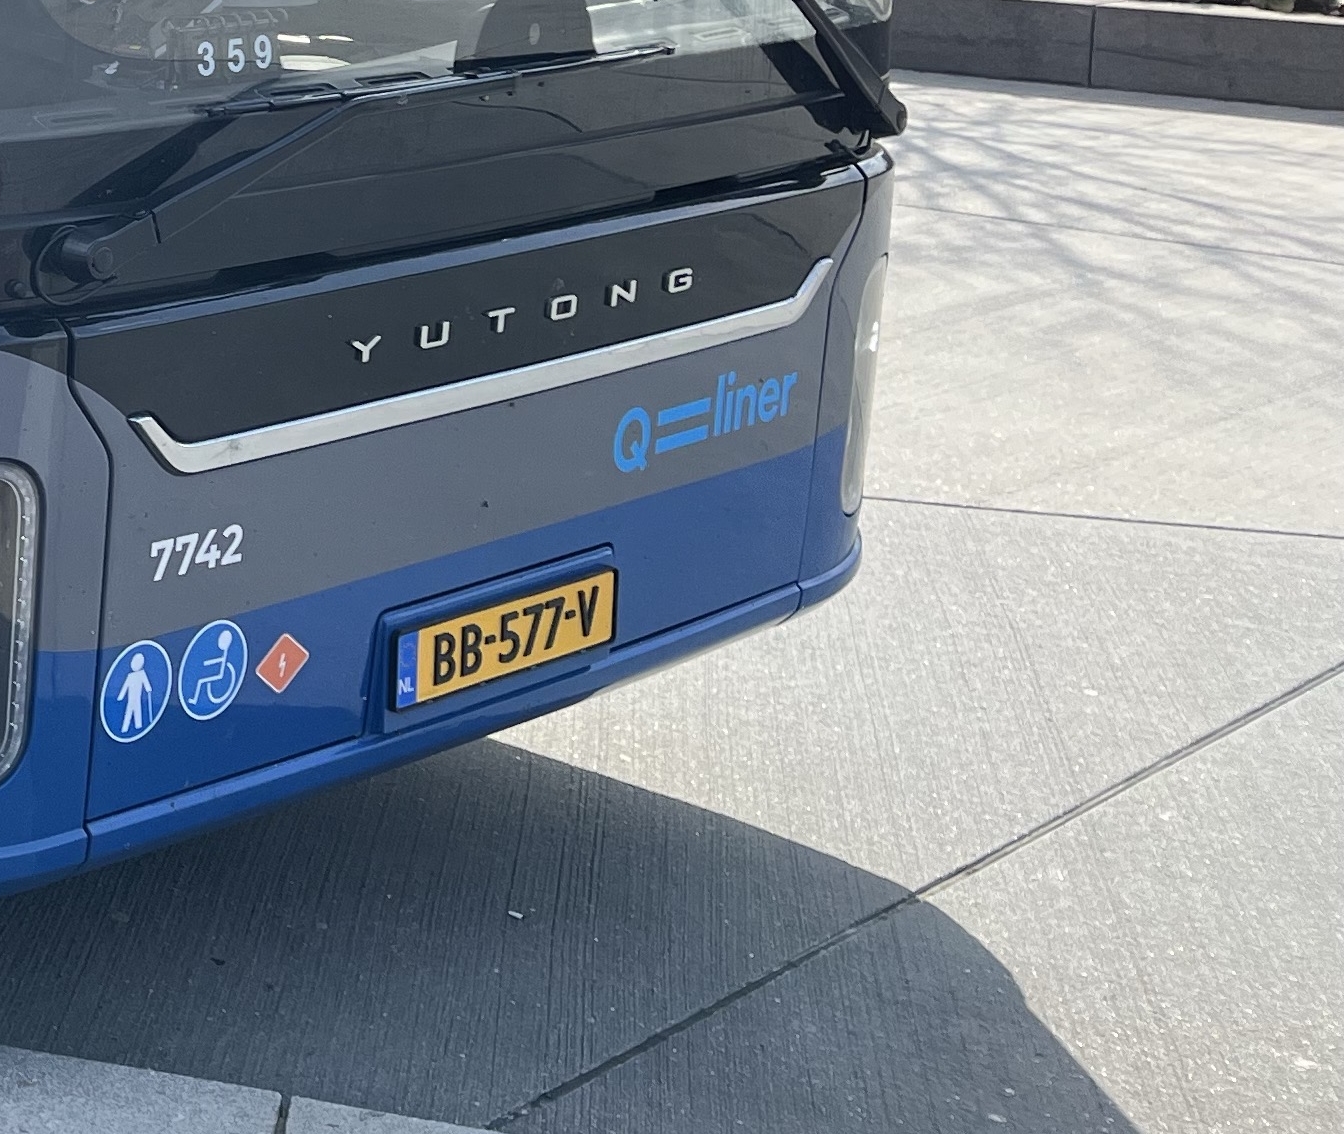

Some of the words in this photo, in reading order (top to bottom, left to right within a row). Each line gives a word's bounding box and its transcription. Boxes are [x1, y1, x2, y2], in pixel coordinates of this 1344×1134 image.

[197, 34, 273, 77] 359
[351, 266, 694, 364] YUTONG
[150, 523, 244, 582] 7742
[432, 585, 600, 687] BB-577-V
[398, 676, 415, 696] NL
